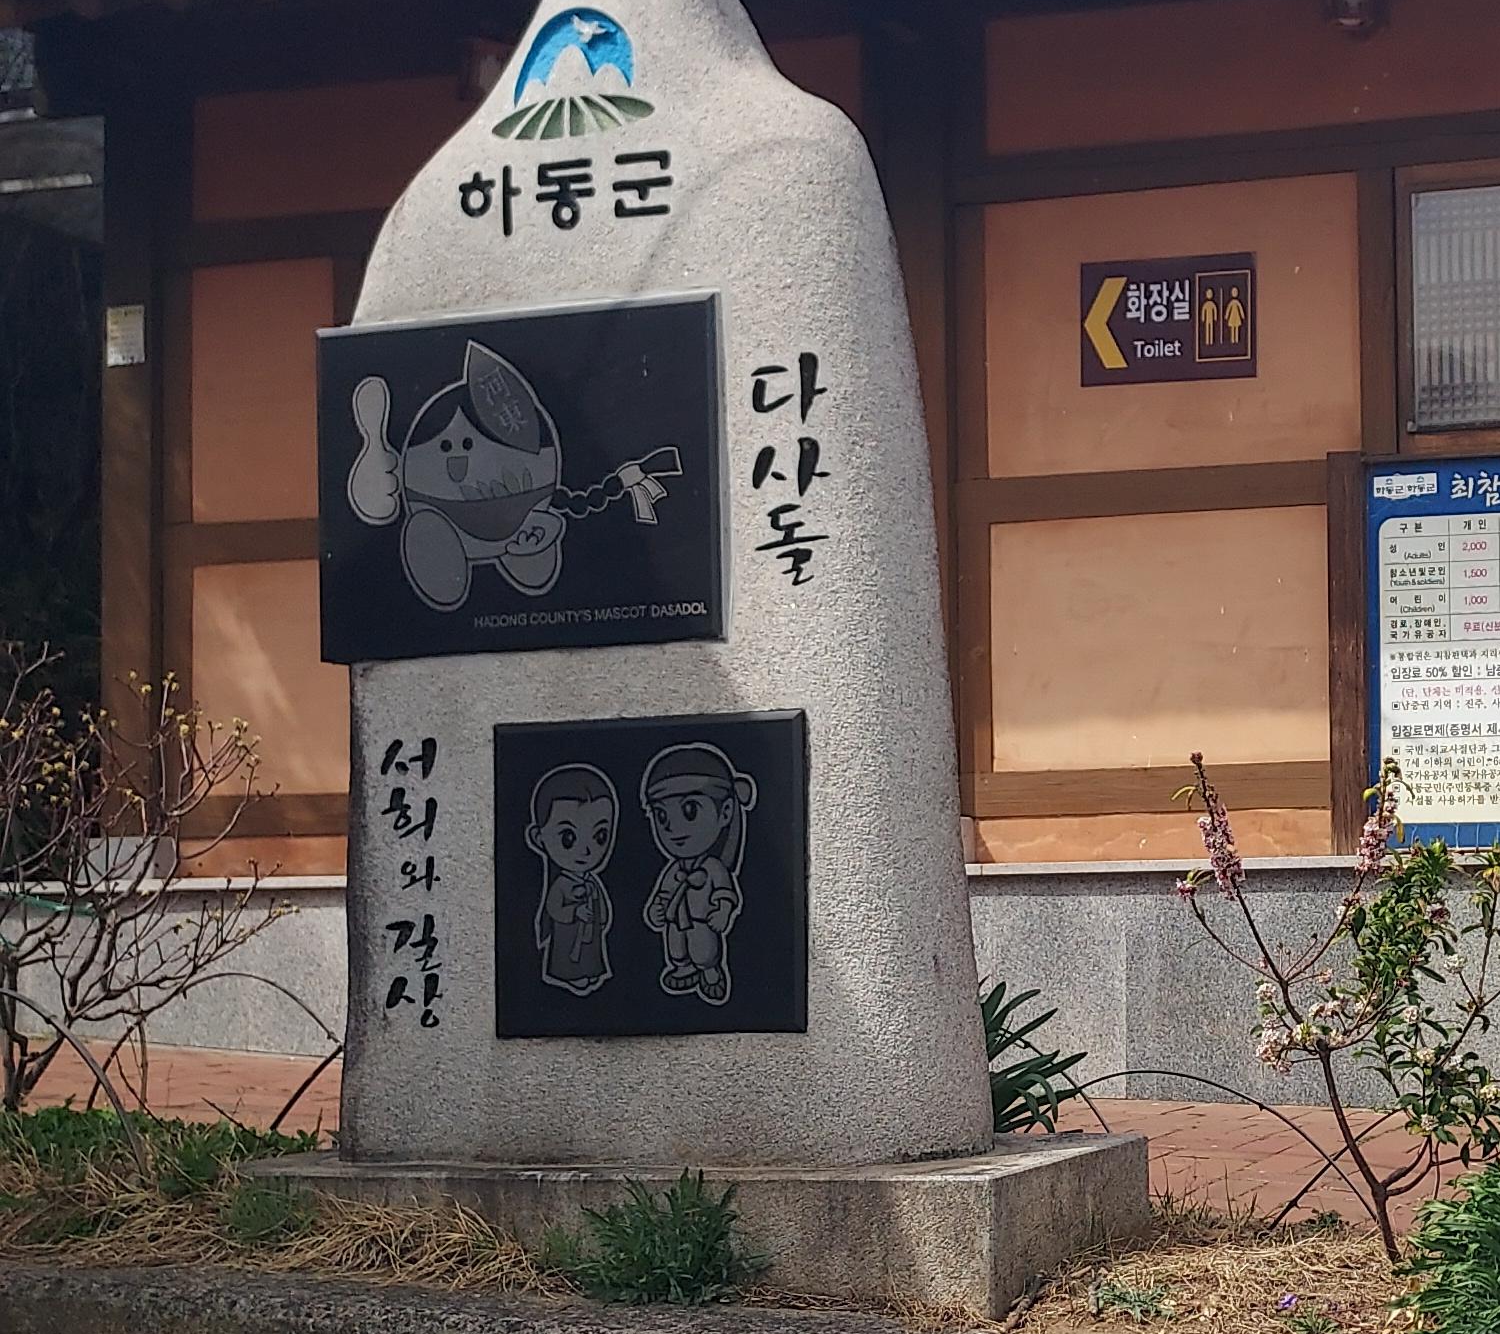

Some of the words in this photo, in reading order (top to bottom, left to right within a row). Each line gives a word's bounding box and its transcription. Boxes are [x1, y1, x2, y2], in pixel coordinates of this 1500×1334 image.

[459, 150, 674, 237] 하동군
[1125, 279, 1190, 323] 화장실
[1134, 339, 1181, 358] Toilet
[750, 352, 831, 586] 다사돌
[1462, 541, 1487, 551] 2,000
[1463, 568, 1487, 578] 1,500
[1464, 596, 1488, 605] 1,000
[474, 613, 528, 628] HADONG
[530, 609, 592, 625] COUNTY'S
[594, 605, 646, 621] MASCOT
[651, 601, 707, 618] DASADOL
[1391, 666, 1422, 680] 입장료
[1425, 666, 1448, 678] 50%
[1452, 665, 1473, 678] 할인
